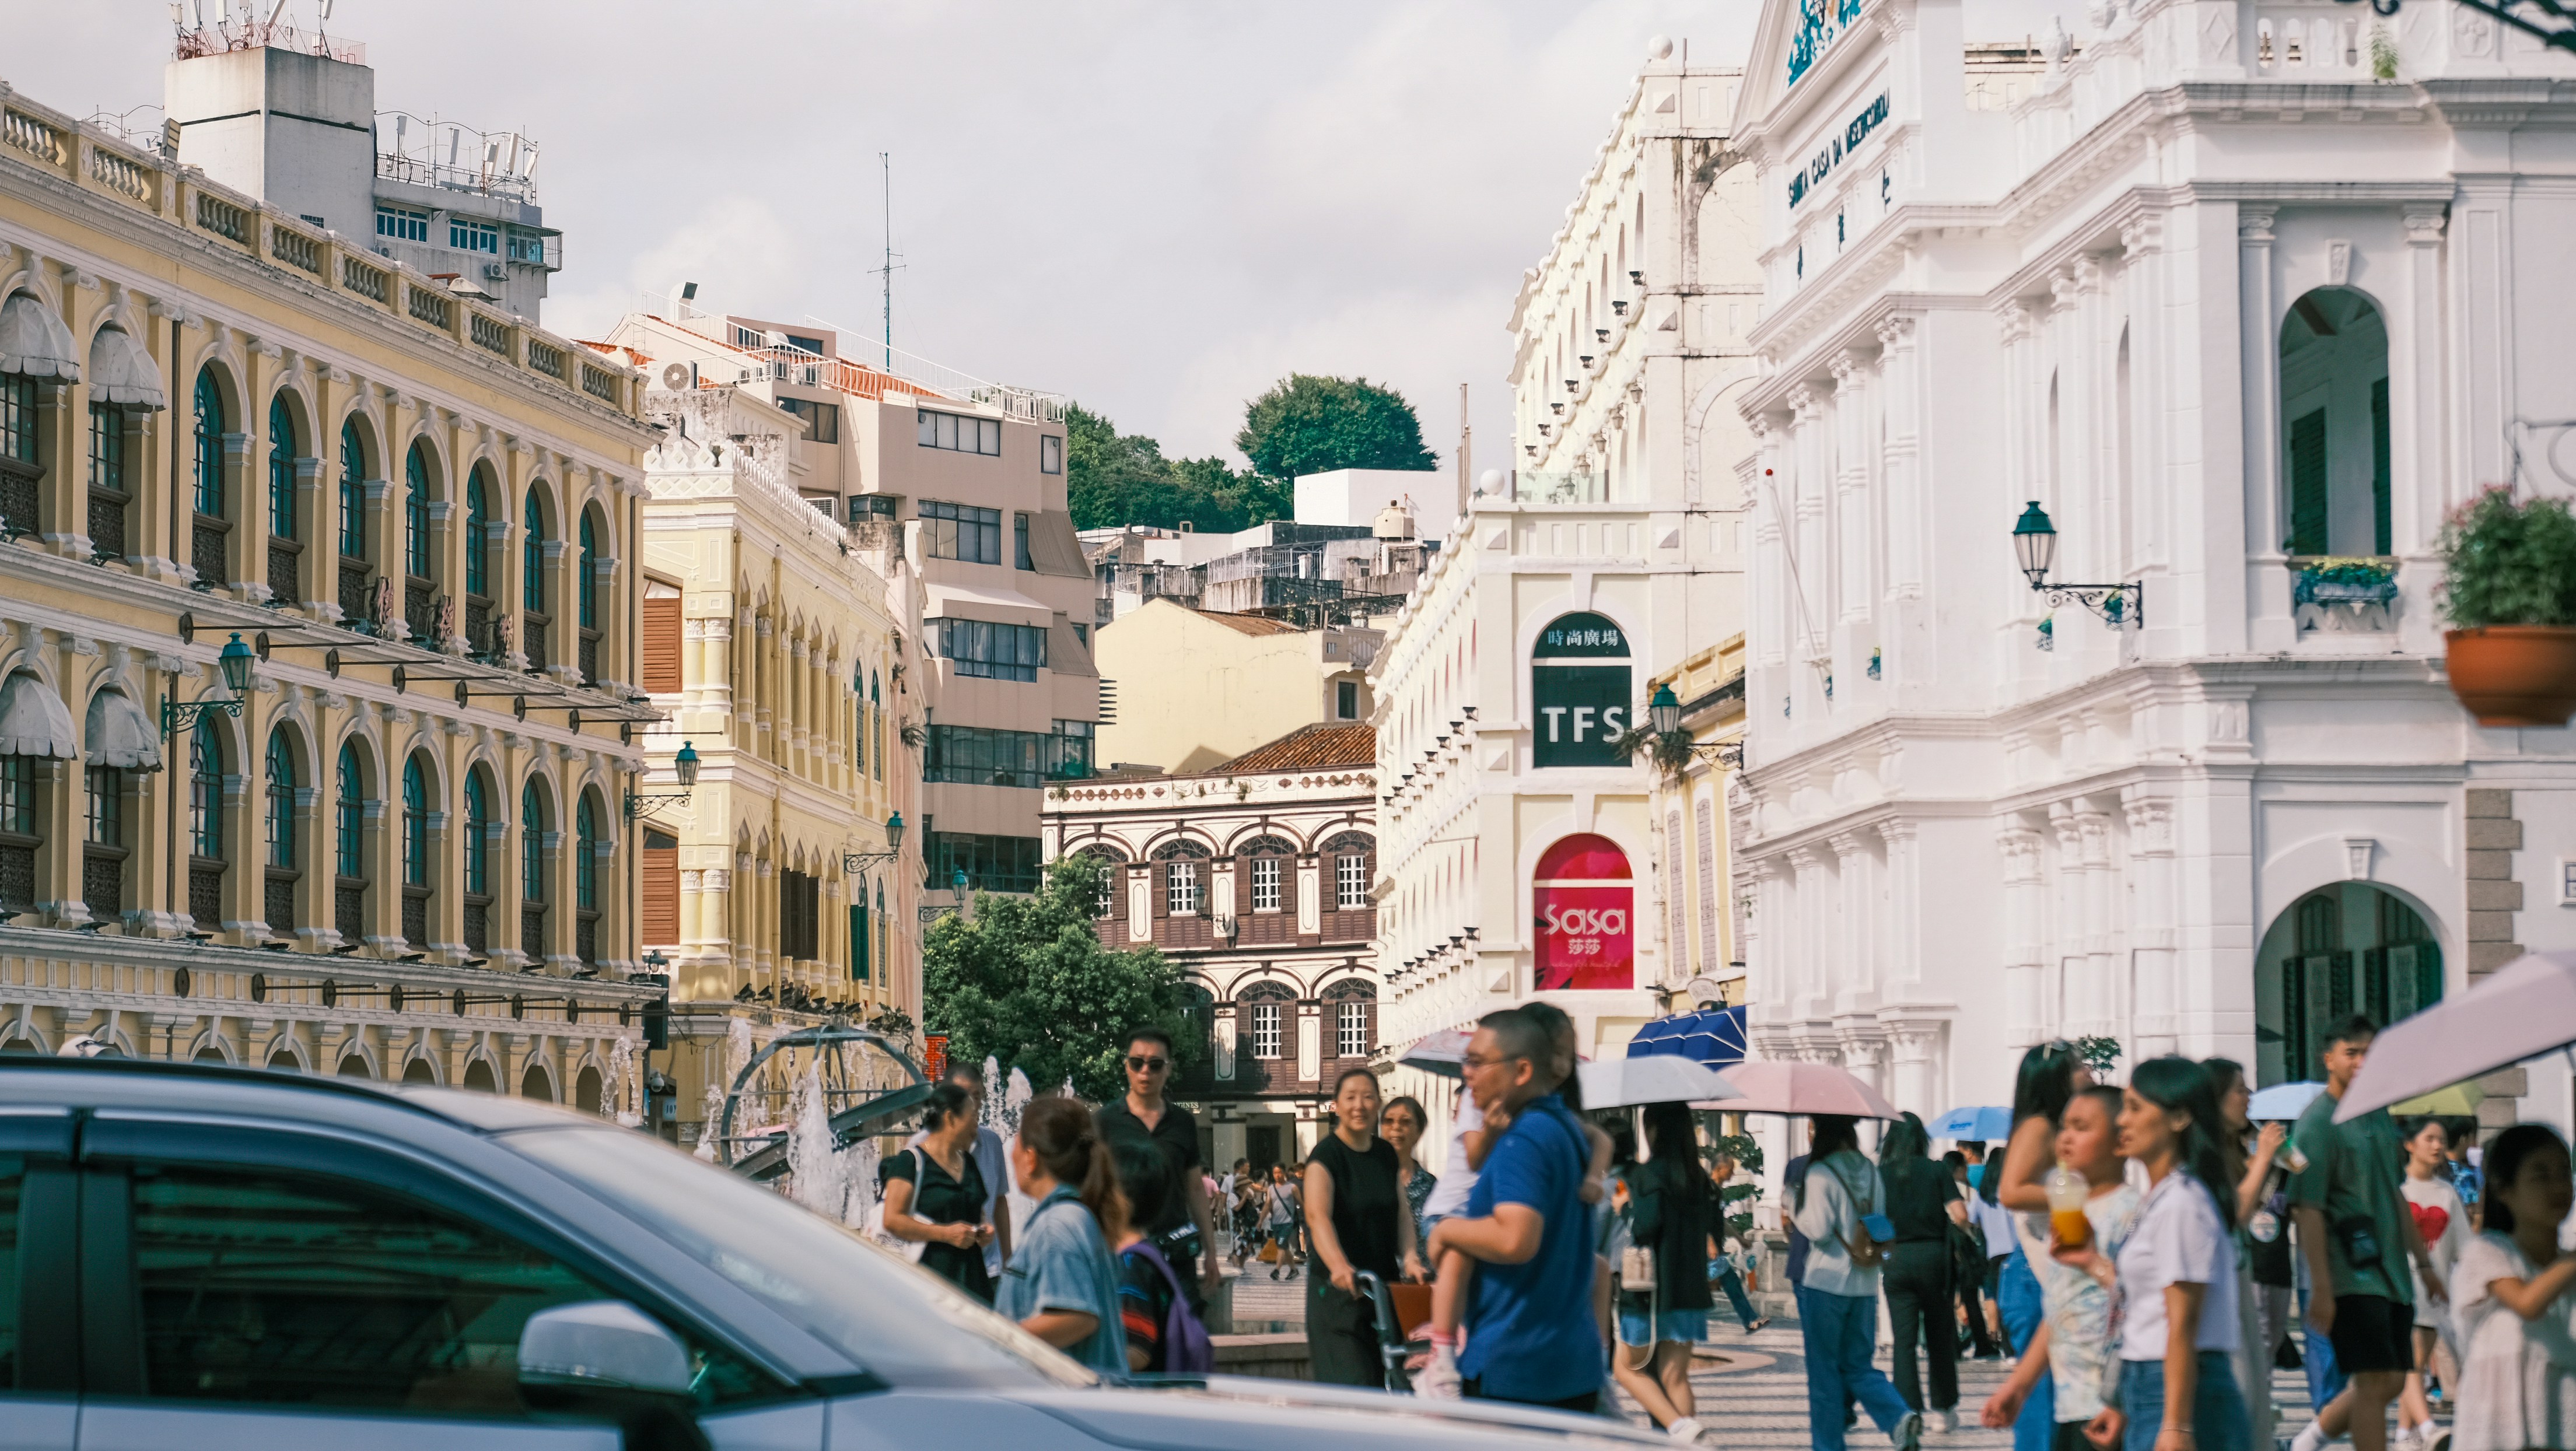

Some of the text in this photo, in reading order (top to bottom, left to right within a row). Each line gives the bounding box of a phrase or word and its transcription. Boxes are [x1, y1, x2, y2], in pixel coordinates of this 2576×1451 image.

[1812, 146, 1831, 185] CASA
[1833, 135, 1843, 167] DA
[1548, 629, 1619, 647] 時尚廣場
[1541, 706, 1625, 743] TFS
[1567, 938, 1601, 955] 莎莎
